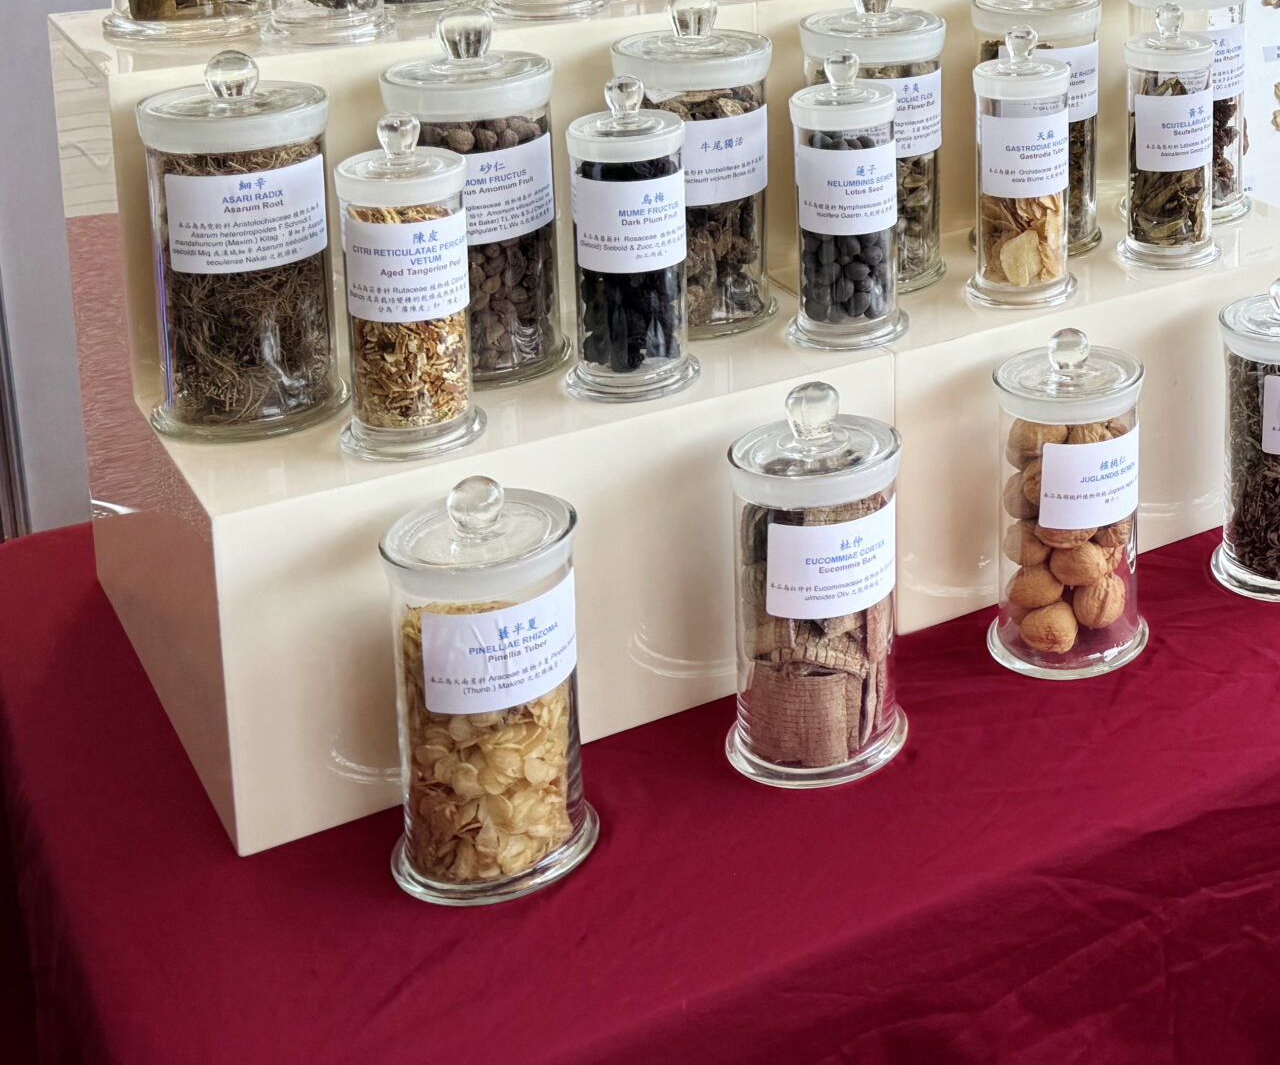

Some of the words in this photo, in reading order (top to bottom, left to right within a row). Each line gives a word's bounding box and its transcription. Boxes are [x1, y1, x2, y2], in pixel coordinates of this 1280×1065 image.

[903, 83, 920, 95] 辛夷
[920, 92, 933, 101] FLOS
[907, 103, 926, 111] Flower
[1161, 117, 1206, 129] SCUTELLARIAE
[1037, 130, 1054, 141] 天麻
[701, 137, 744, 152] 牛尾獨活
[1006, 143, 1051, 152] GASTRODIAE
[1020, 152, 1051, 160] Gastrodia
[480, 162, 505, 174] 砂仁
[856, 165, 876, 176] 蓮子
[489, 169, 527, 183] FRUCTUS
[238, 177, 266, 190] 細辛
[479, 182, 517, 194] Amomum
[519, 176, 534, 185] Fruit
[827, 179, 875, 187] NELUMBINIS
[222, 193, 252, 204] ASARI
[254, 189, 283, 201] RADIX
[845, 188, 866, 196] Lotus
[868, 185, 883, 193] Seed
[641, 192, 665, 206] 烏梅
[223, 206, 260, 214] Asarum
[262, 199, 284, 210] Root
[618, 209, 646, 217] MUME
[647, 202, 679, 215] FRUCTUS
[233, 214, 291, 228] Aristolochiaceae
[621, 218, 641, 226] Dark
[643, 216, 663, 225] Plum
[413, 230, 439, 244] 陳皮
[624, 234, 657, 242] Rosaceae
[353, 245, 372, 255] CITRI
[373, 246, 437, 257] RETICULATAE
[380, 269, 403, 278] Aged
[406, 263, 448, 276] Tangerine
[449, 256, 461, 267] Peel
[410, 255, 442, 266] VETUM
[393, 286, 428, 294] Rutaceae
[1080, 469, 1119, 483] JUGLANDIS
[840, 536, 863, 551] 杜仲
[805, 552, 858, 565] EUCOMMIAE
[860, 540, 885, 555] CORTEX
[819, 561, 860, 574] Eucommia
[862, 555, 876, 565] Bark
[469, 639, 520, 655] PINELLIAE
[522, 622, 559, 644] RHIZOMA
[488, 650, 521, 663] Pinellia
[525, 639, 548, 652] Tuber
